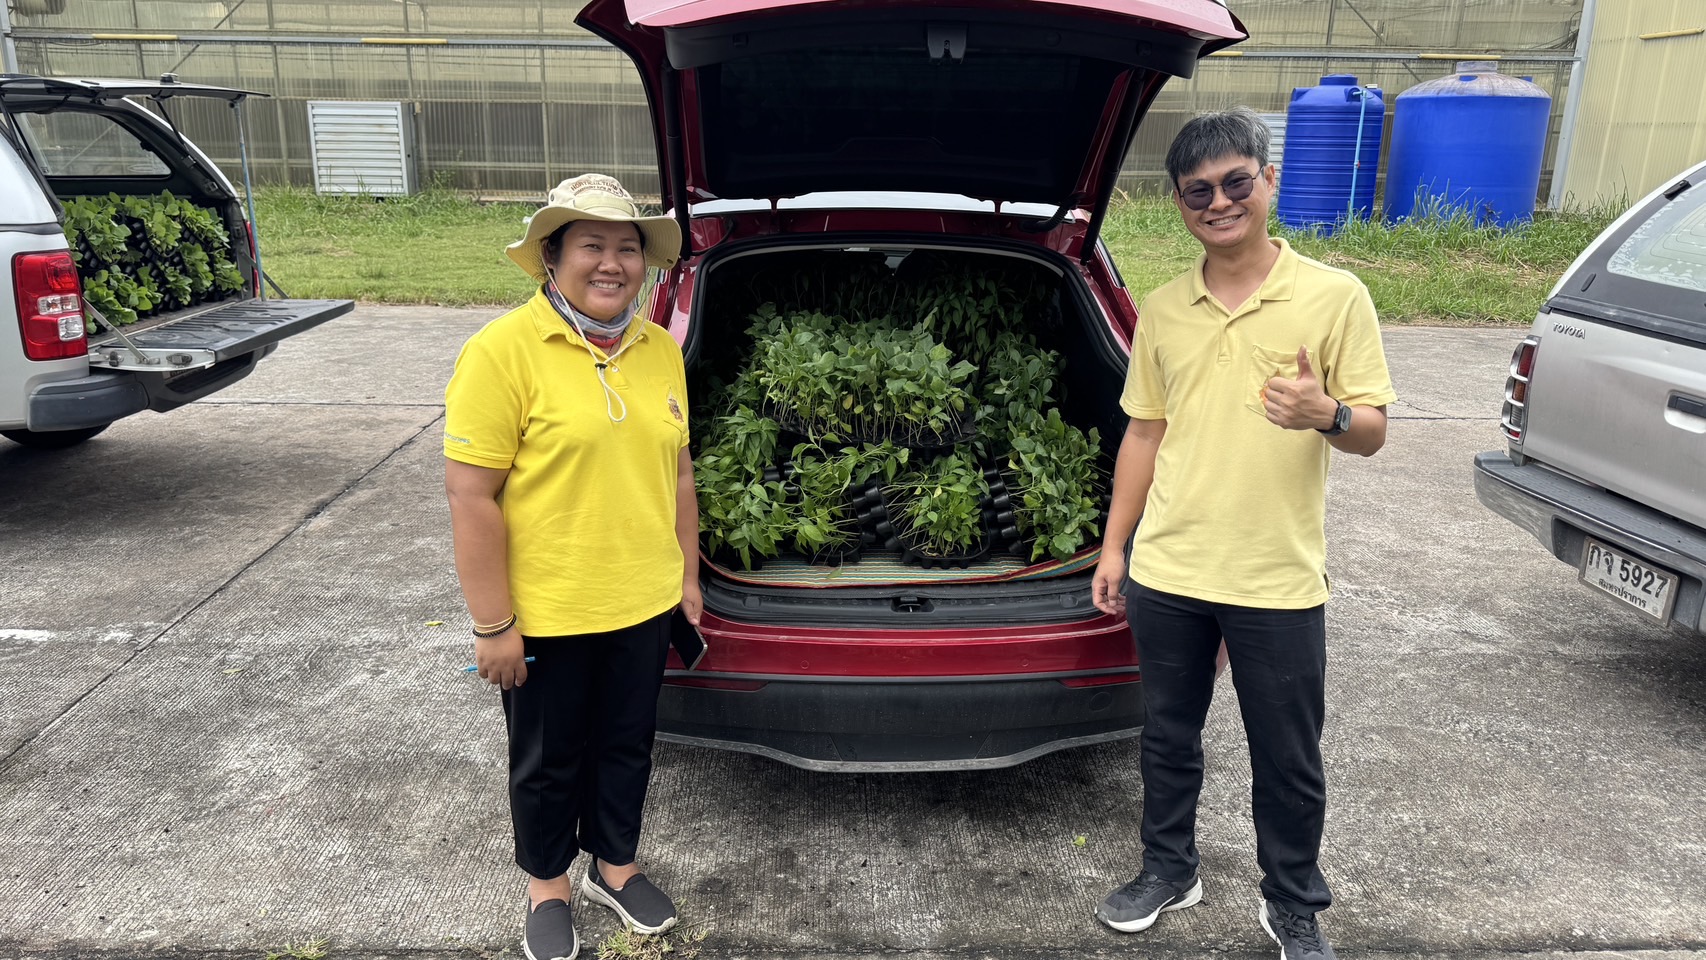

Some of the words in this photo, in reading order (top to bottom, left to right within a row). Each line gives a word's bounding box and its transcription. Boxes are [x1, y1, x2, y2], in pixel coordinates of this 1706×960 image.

[1553, 322, 1585, 340] TOYOTA
[1598, 578, 1646, 608] สมทรปราการ
[1619, 559, 1668, 598] 5927
